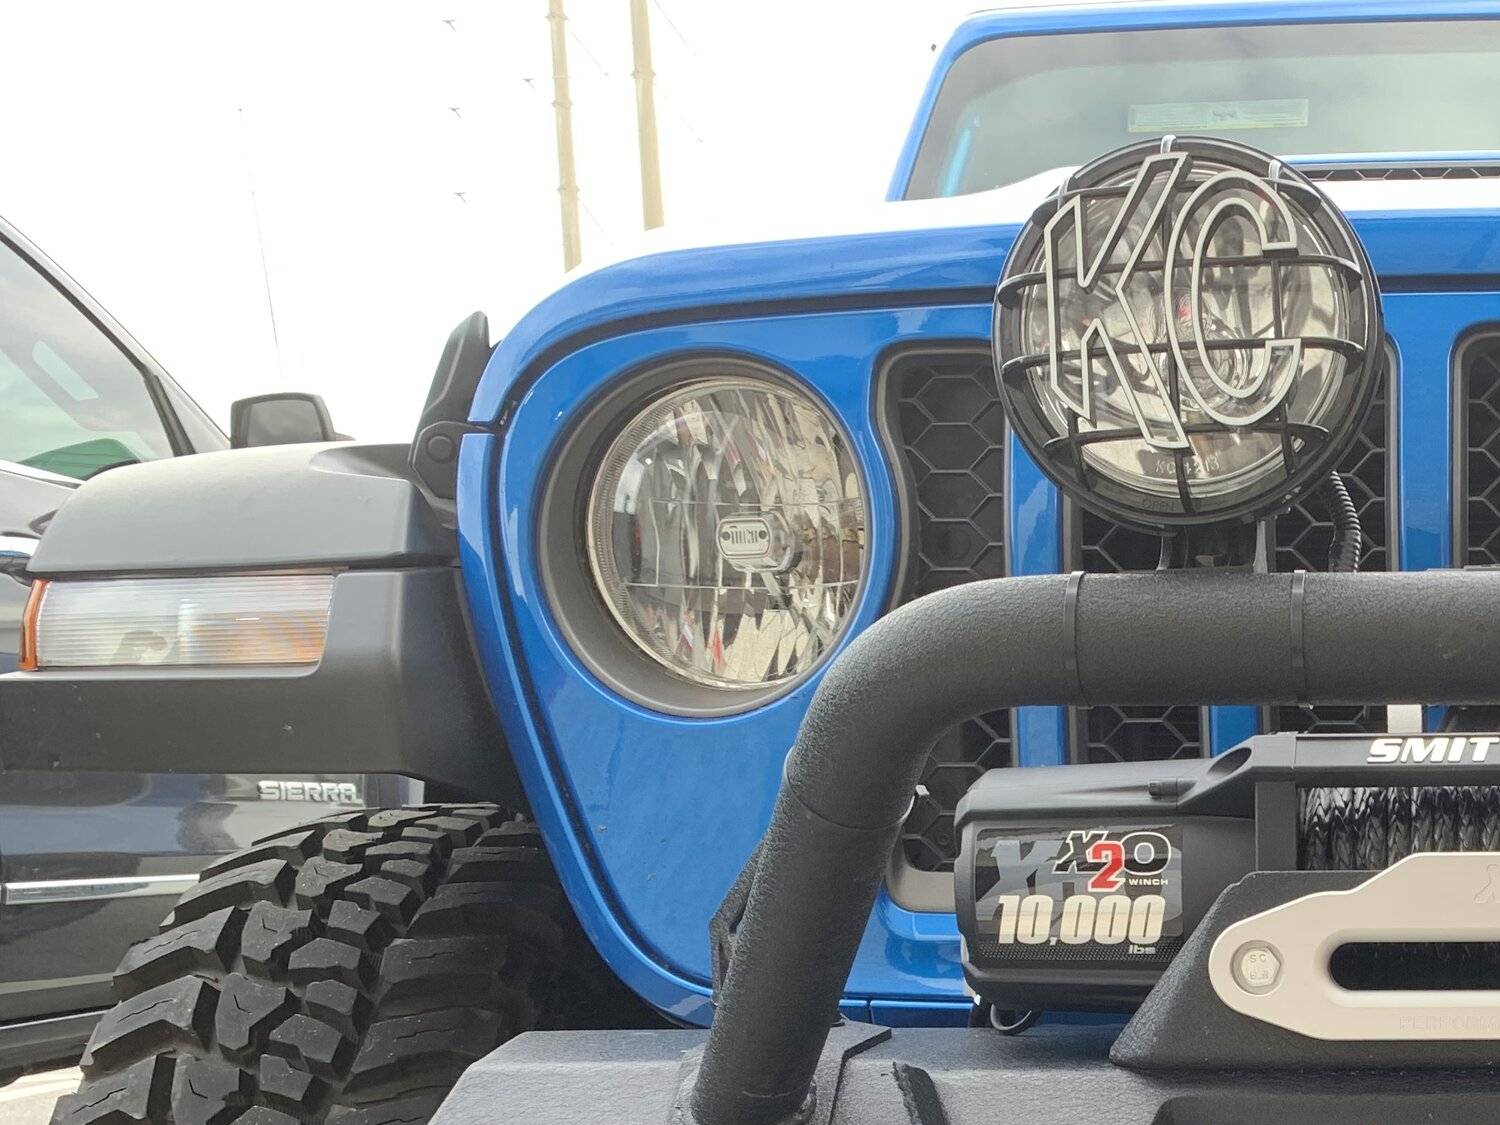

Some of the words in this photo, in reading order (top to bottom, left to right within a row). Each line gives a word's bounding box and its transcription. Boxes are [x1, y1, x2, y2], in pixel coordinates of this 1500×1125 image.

[1045, 152, 1301, 449] KC
[257, 780, 357, 802] SIERRA
[1128, 878, 1169, 886] WINCH
[998, 894, 1166, 946] 10,000
[1128, 944, 1157, 955] lbs
